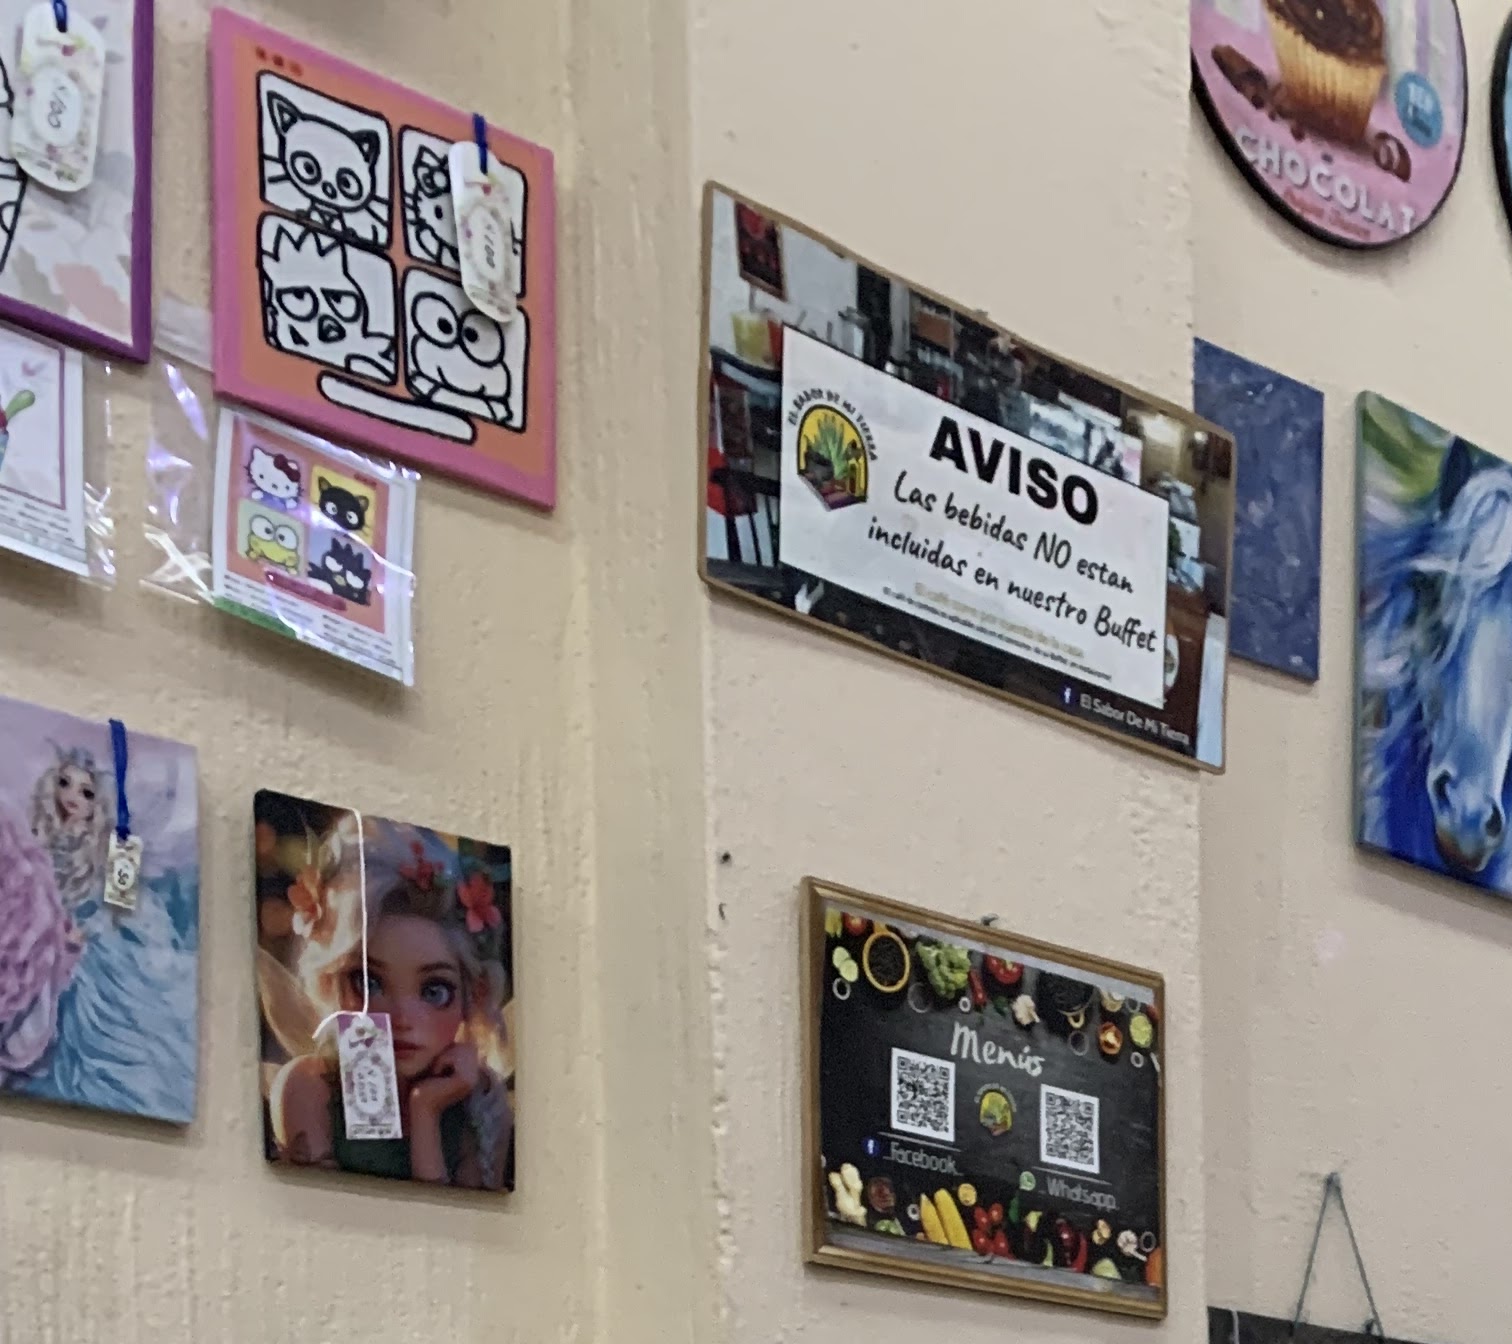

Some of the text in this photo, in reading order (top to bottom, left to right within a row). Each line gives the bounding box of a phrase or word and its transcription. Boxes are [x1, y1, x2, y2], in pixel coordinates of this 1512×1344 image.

[894, 470, 1134, 594] Las bebidas NO estan
[929, 416, 1099, 526] AVISO
[868, 516, 968, 577] incluidas
[974, 567, 999, 591] en
[1007, 581, 1088, 625] nuestro
[1094, 605, 1157, 653] Buffet
